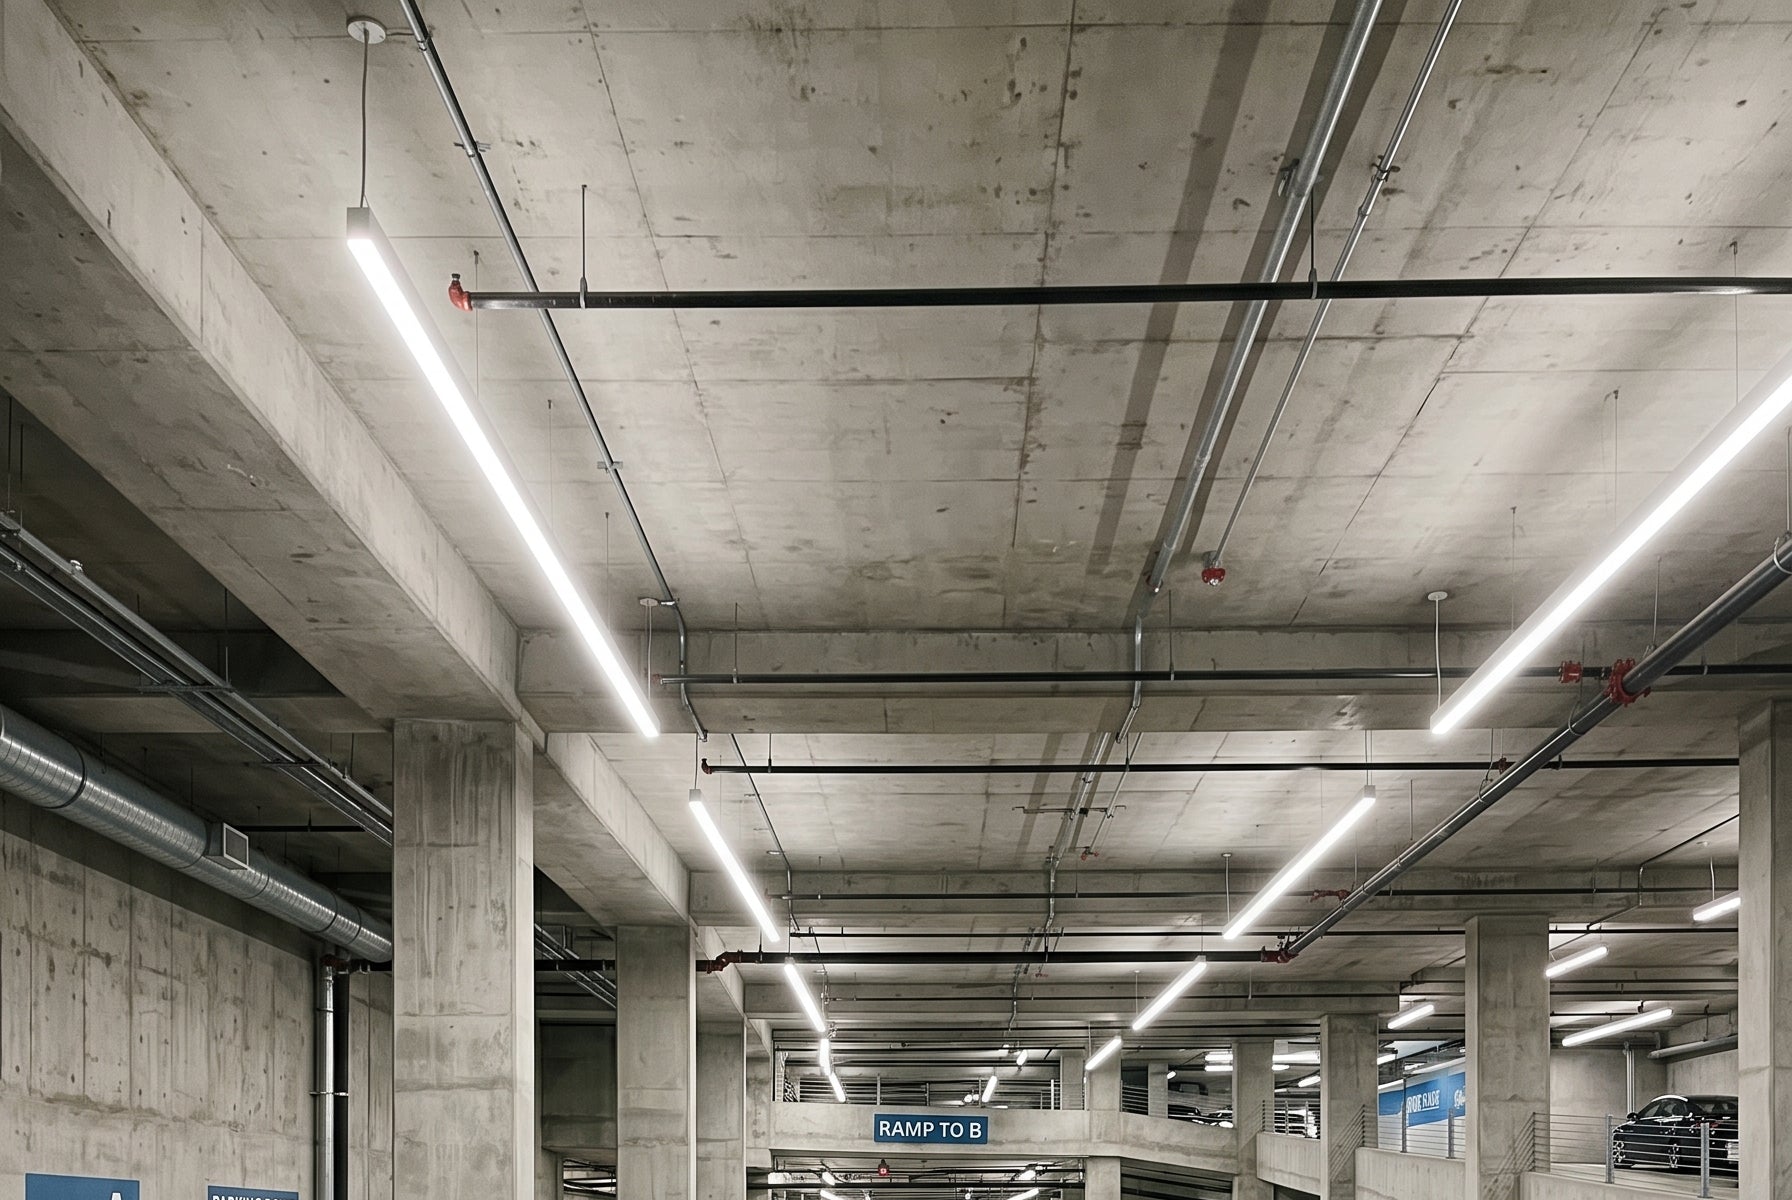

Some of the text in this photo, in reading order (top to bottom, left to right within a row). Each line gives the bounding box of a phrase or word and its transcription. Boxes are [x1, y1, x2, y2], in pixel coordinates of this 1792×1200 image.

[879, 1121, 982, 1138] RAMP TO B
